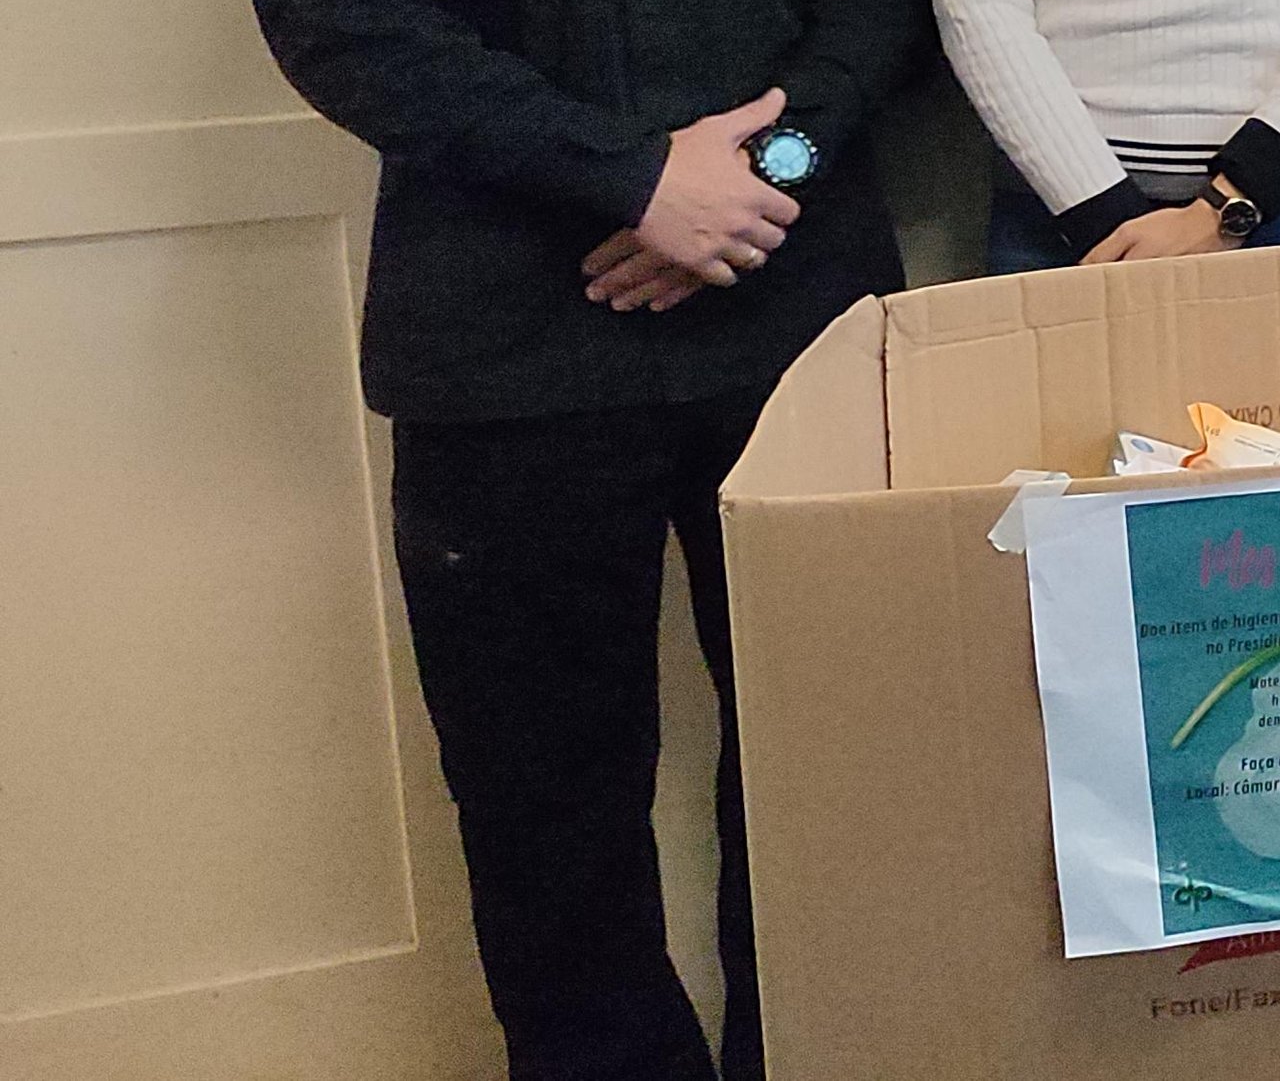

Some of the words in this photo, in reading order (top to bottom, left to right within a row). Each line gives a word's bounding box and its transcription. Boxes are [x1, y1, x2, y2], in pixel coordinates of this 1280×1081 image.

[1140, 623, 1167, 638] Doe
[1170, 619, 1207, 634] itens
[1211, 616, 1228, 630] de
[1206, 642, 1222, 655] no
[1241, 756, 1274, 773] Faça
[1186, 784, 1230, 801] Local:
